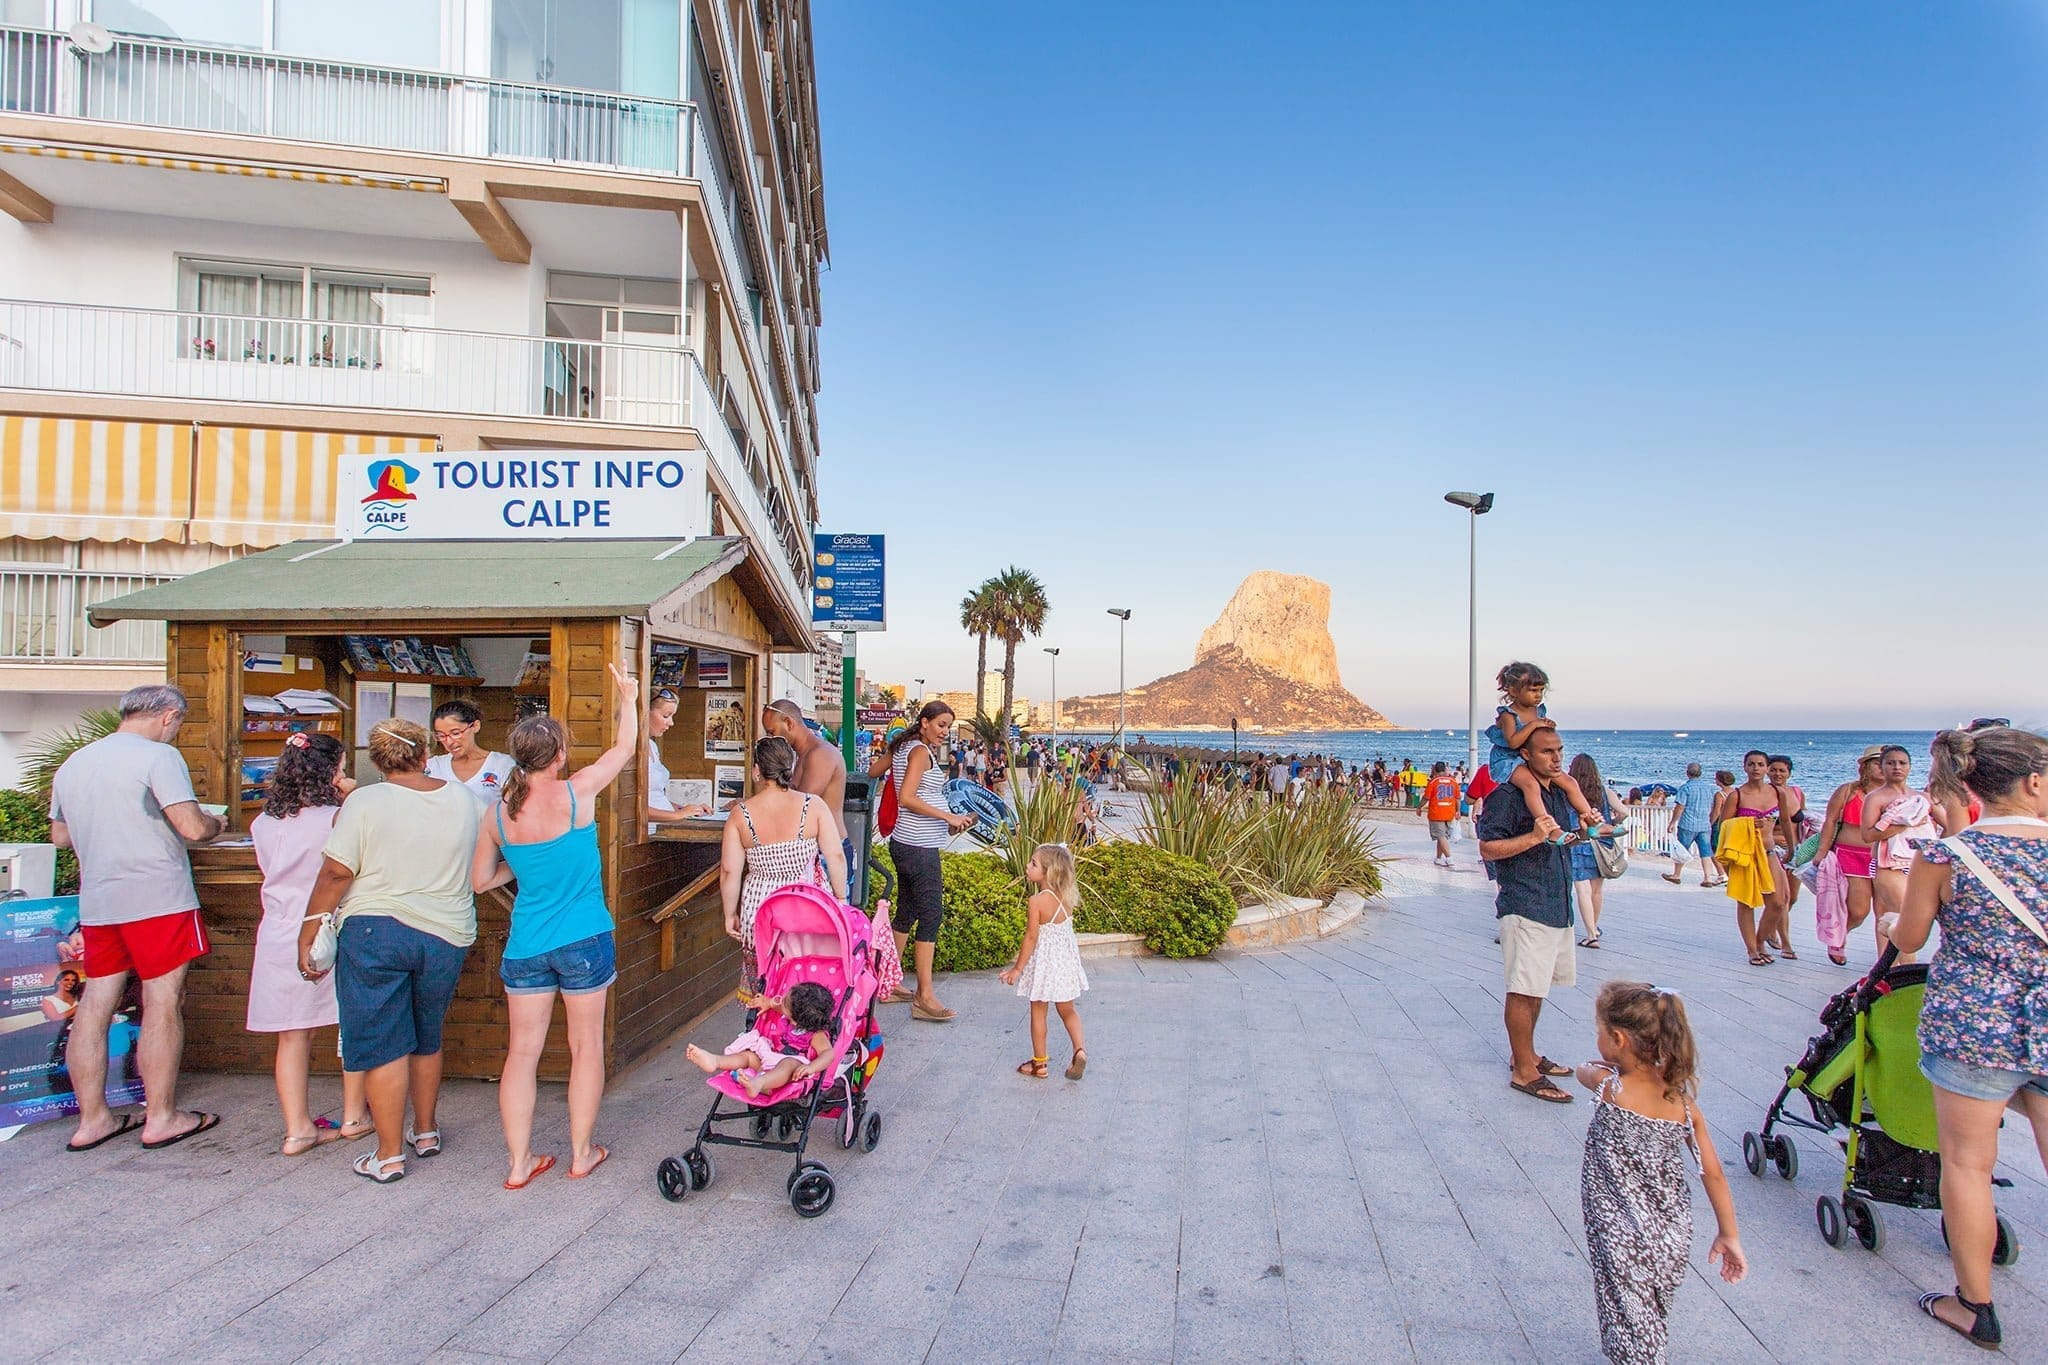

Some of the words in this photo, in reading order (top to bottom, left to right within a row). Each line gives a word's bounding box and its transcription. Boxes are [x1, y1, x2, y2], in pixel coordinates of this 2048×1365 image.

[433, 460, 580, 489] TOURIST
[595, 460, 684, 488] INFO
[366, 512, 406, 523] CALPE
[503, 499, 611, 528] CALPE
[833, 535, 870, 545] Gracias!
[12, 973, 44, 981] PUESTA
[11, 996, 43, 1004] SUNSET
[9, 1061, 59, 1075] INMERSIÓN
[8, 1081, 30, 1091] DIVE
